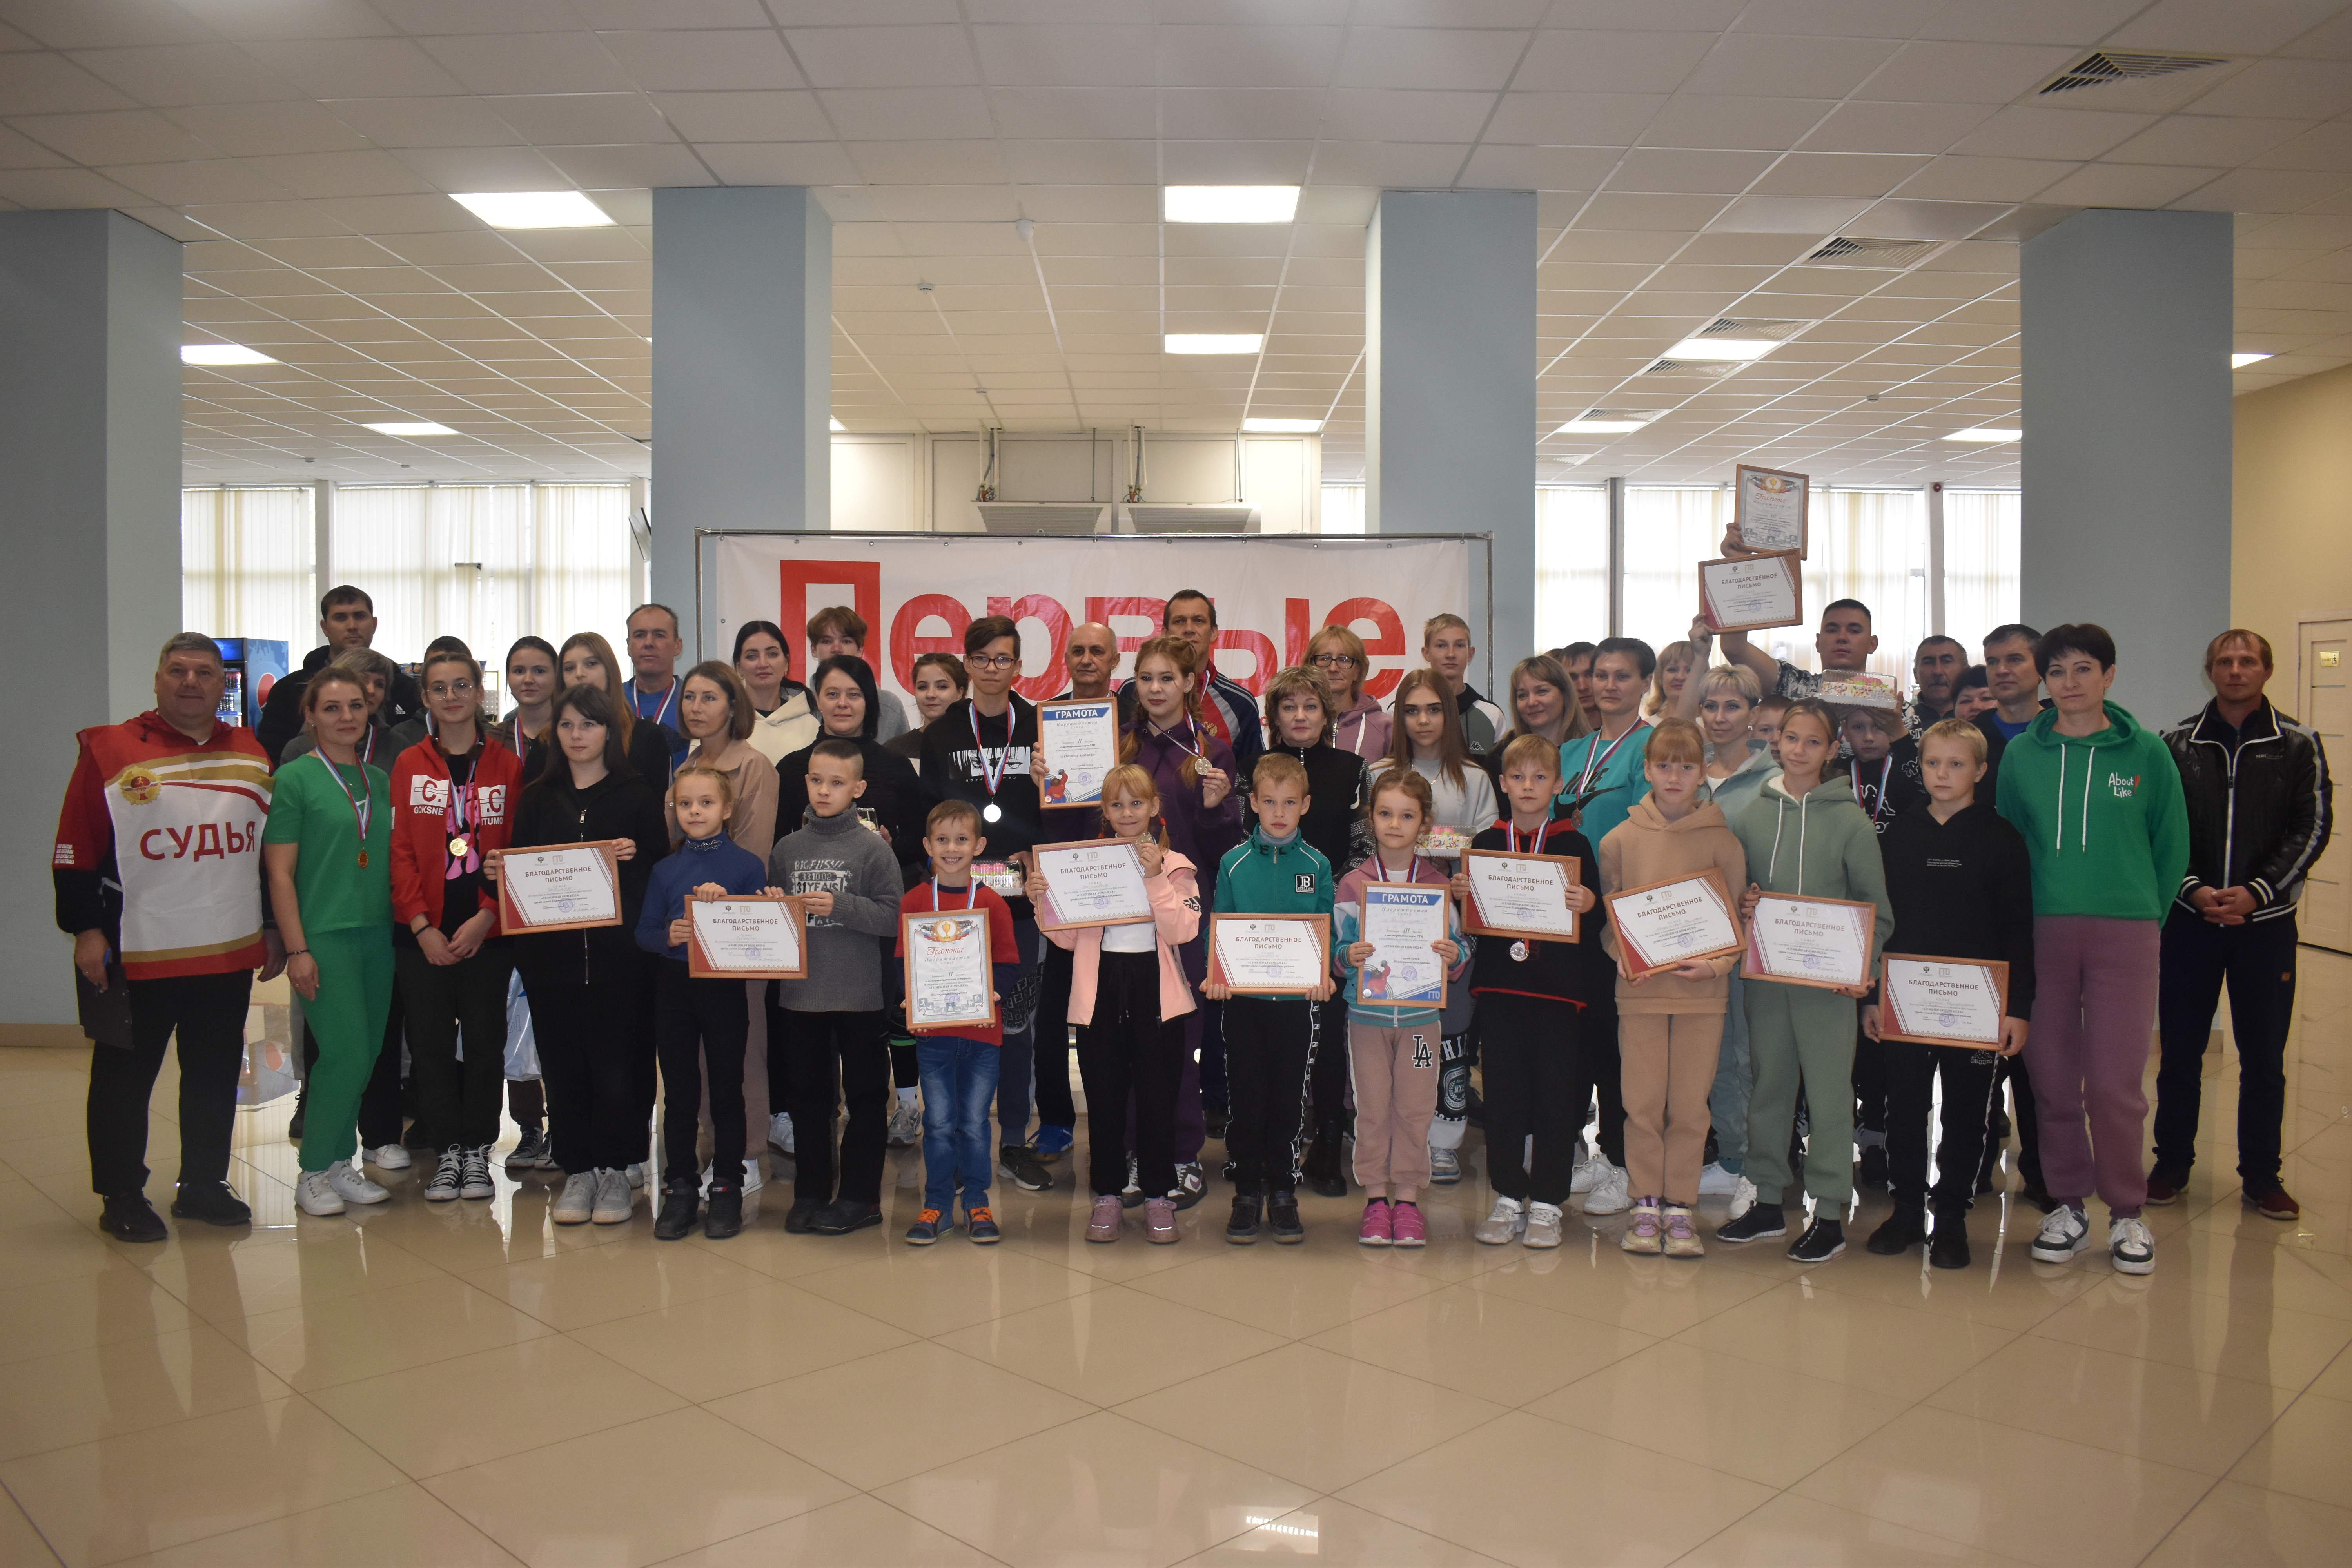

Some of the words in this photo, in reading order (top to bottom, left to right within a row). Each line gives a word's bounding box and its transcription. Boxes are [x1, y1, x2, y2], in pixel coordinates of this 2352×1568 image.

[1756, 493, 1786, 503] Грамота
[1722, 573, 1777, 584] БЛАГОДАРСТВЕННОЕ
[1056, 709, 1098, 719] ГРАМОТА
[2108, 772, 2134, 787] About
[2114, 786, 2132, 798] Like
[414, 806, 444, 816] GOKSNE
[140, 821, 256, 862] СУДЬЯ
[525, 866, 592, 877] БЛАГОДАРСТВЕННОЕ
[1060, 863, 1126, 873] БЛАГОДАРСТВЕННОЕ
[1489, 875, 1553, 885] БЛАГОДАРСТВЕННОЕ
[1382, 894, 1428, 904] ГРАМОТА
[1637, 897, 1702, 918] БЛАГОДАРСТВЕННОЕ
[1659, 909, 1686, 920] ПИСЬМО
[1775, 918, 1844, 931] БЛАГОДАРСТВЕННОЕ
[927, 947, 964, 957] Грамота
[1909, 980, 1978, 990] БЛАГОДАРСТВЕННОЕ
[1412, 1034, 1433, 1068] LA
